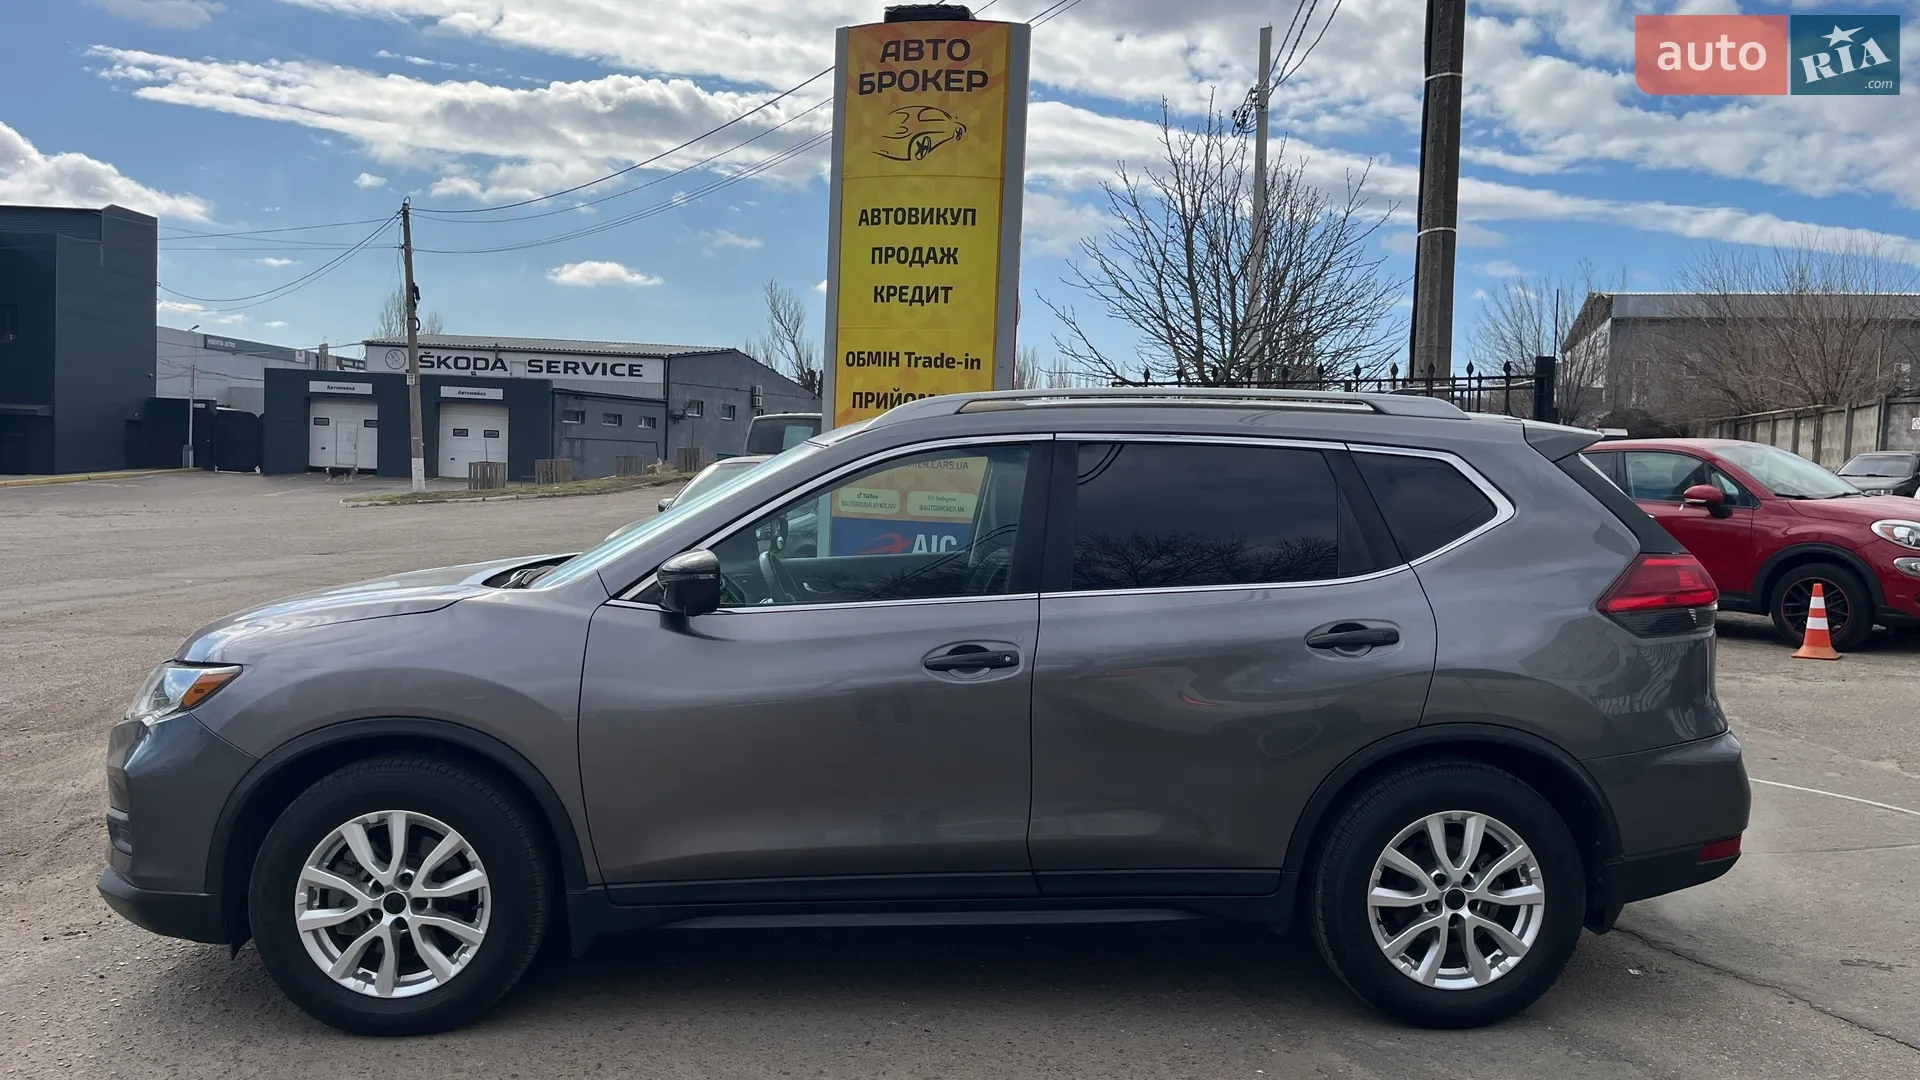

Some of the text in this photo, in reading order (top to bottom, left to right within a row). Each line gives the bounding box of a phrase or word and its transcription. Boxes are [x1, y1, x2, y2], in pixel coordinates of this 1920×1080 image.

[879, 38, 971, 63] АВТО
[858, 69, 989, 96] БРОКЕР
[858, 207, 977, 226] АВТОВИКУП
[871, 246, 959, 267] ПРОДАЖ
[873, 285, 953, 307] КРЕДИТ
[418, 351, 643, 377] ŠKODA SERVICE
[845, 351, 981, 370] ОБМІН Trade-in
